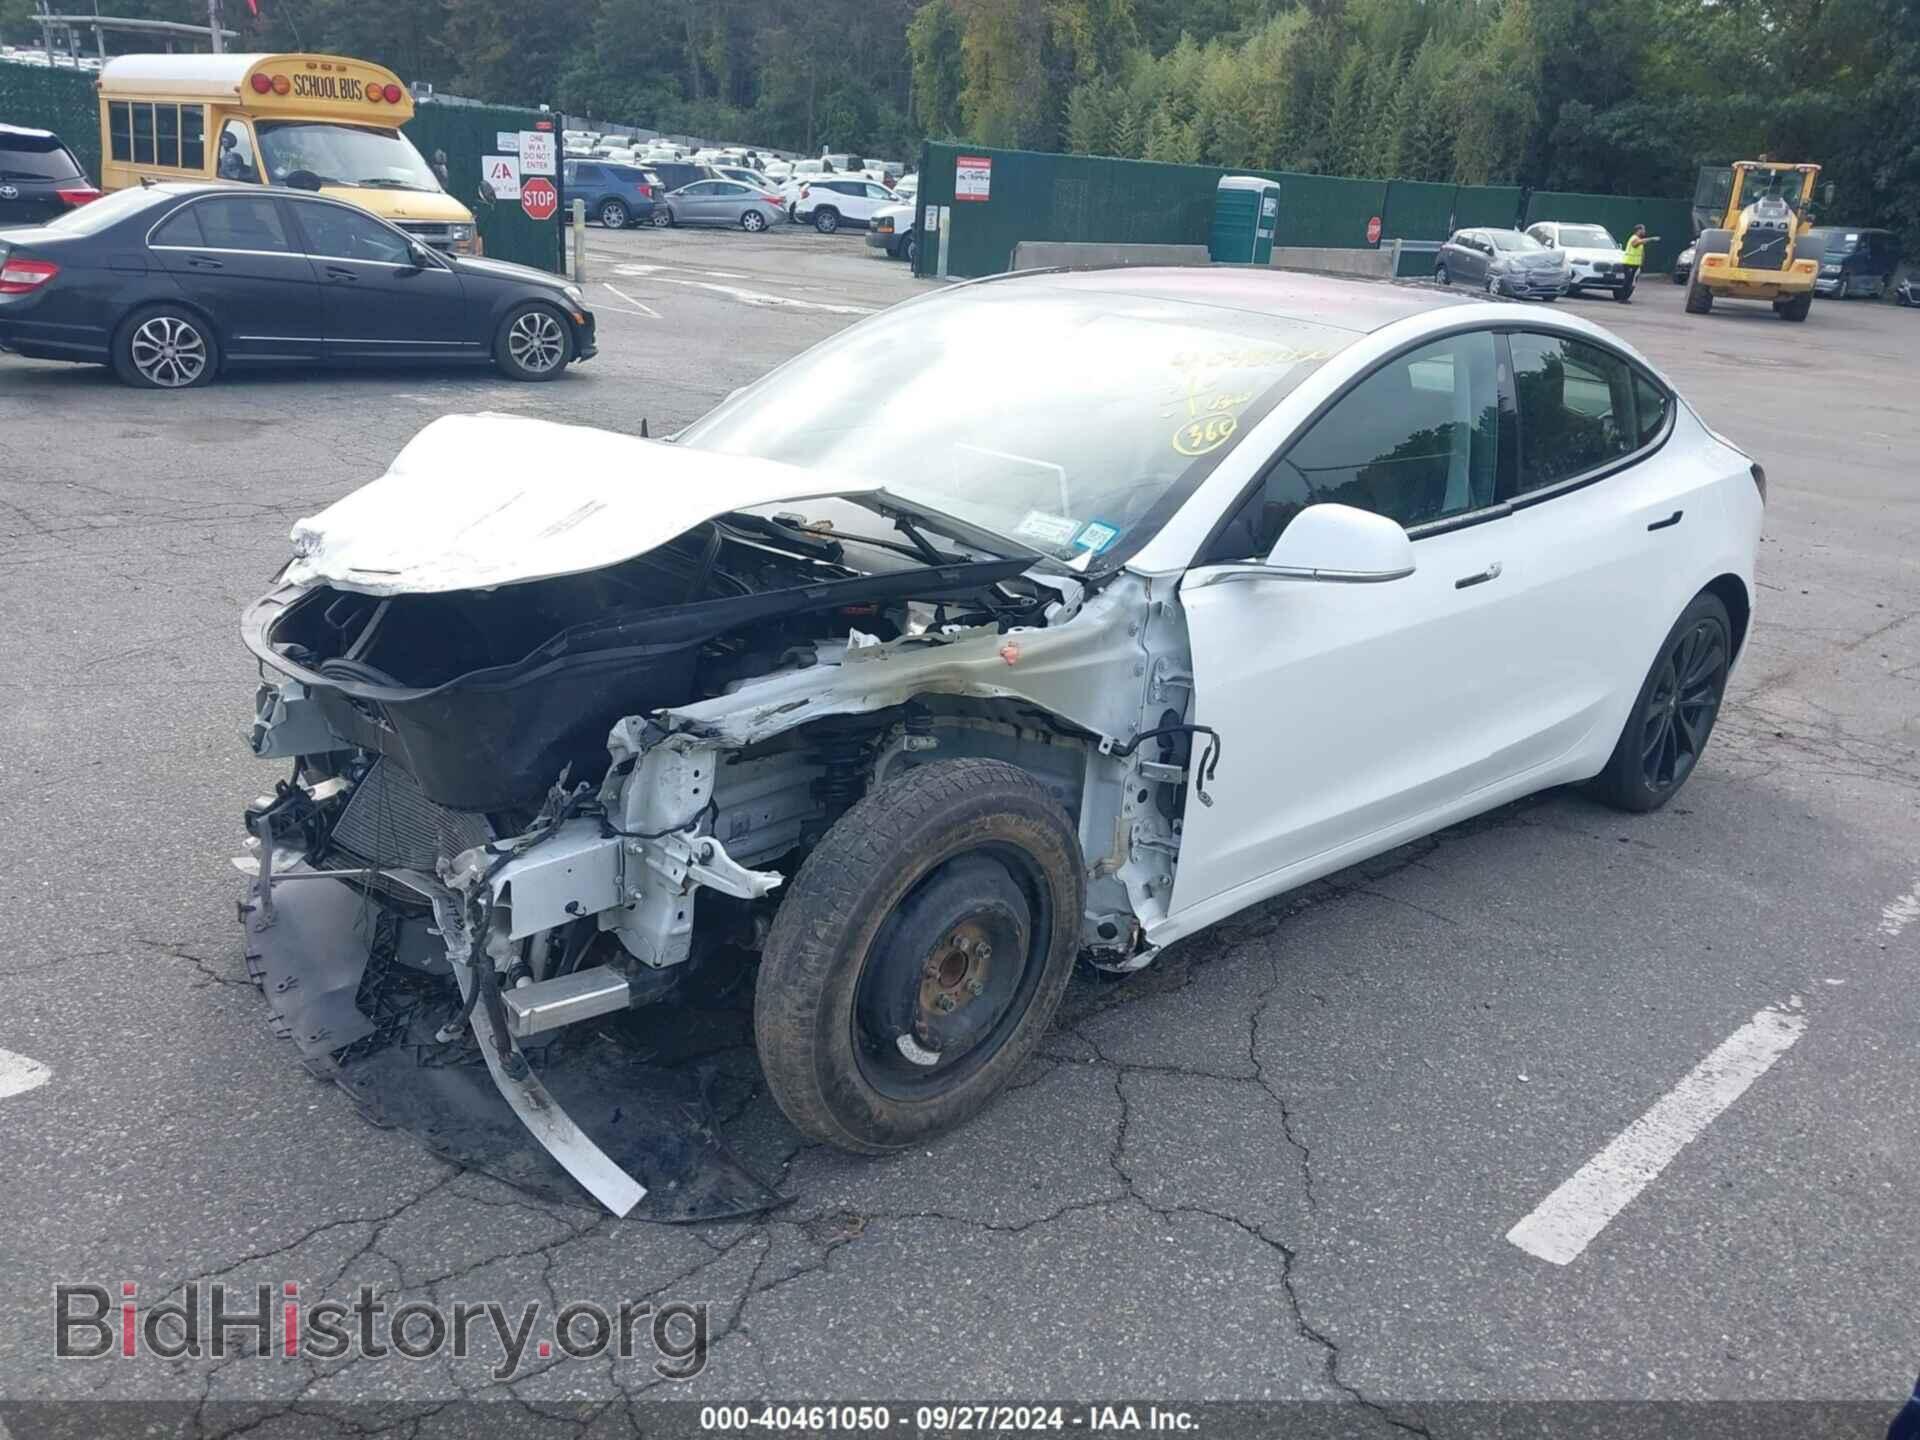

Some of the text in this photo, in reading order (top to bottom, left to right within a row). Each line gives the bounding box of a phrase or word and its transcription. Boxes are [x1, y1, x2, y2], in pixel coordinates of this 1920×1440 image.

[294, 74, 362, 101] SCHOOL BUS
[523, 152, 551, 160] DO NOT
[526, 161, 548, 169] ENTER
[524, 191, 554, 206] STOP
